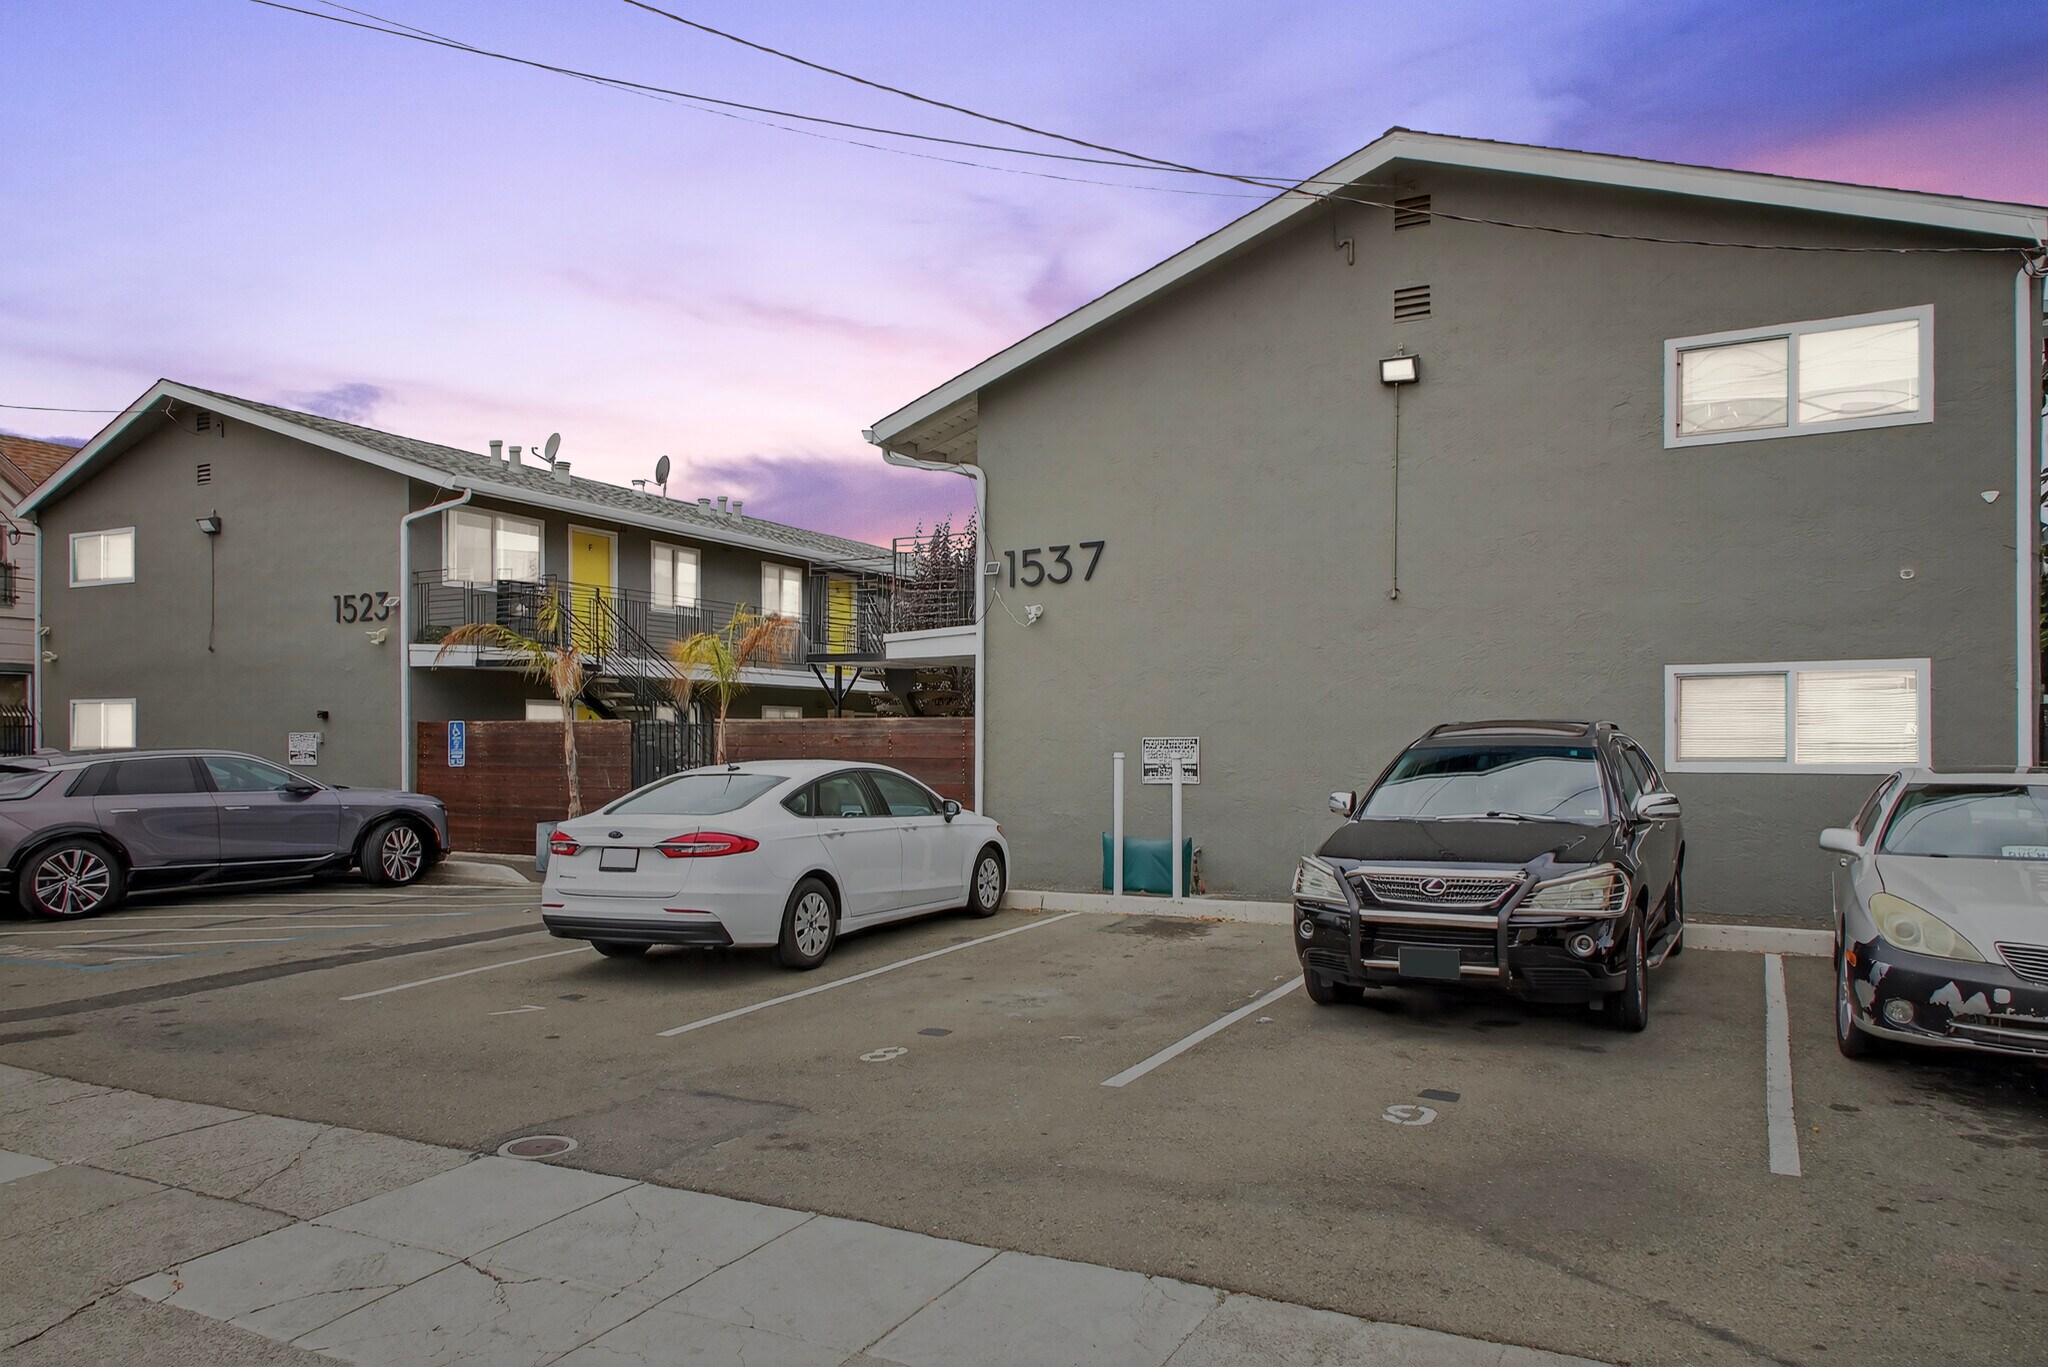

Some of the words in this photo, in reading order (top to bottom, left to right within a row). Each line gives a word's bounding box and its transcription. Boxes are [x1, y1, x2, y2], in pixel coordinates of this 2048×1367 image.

[1004, 540, 1105, 588] 1537
[333, 591, 390, 624] 1523
[859, 1046, 909, 1062] 8
